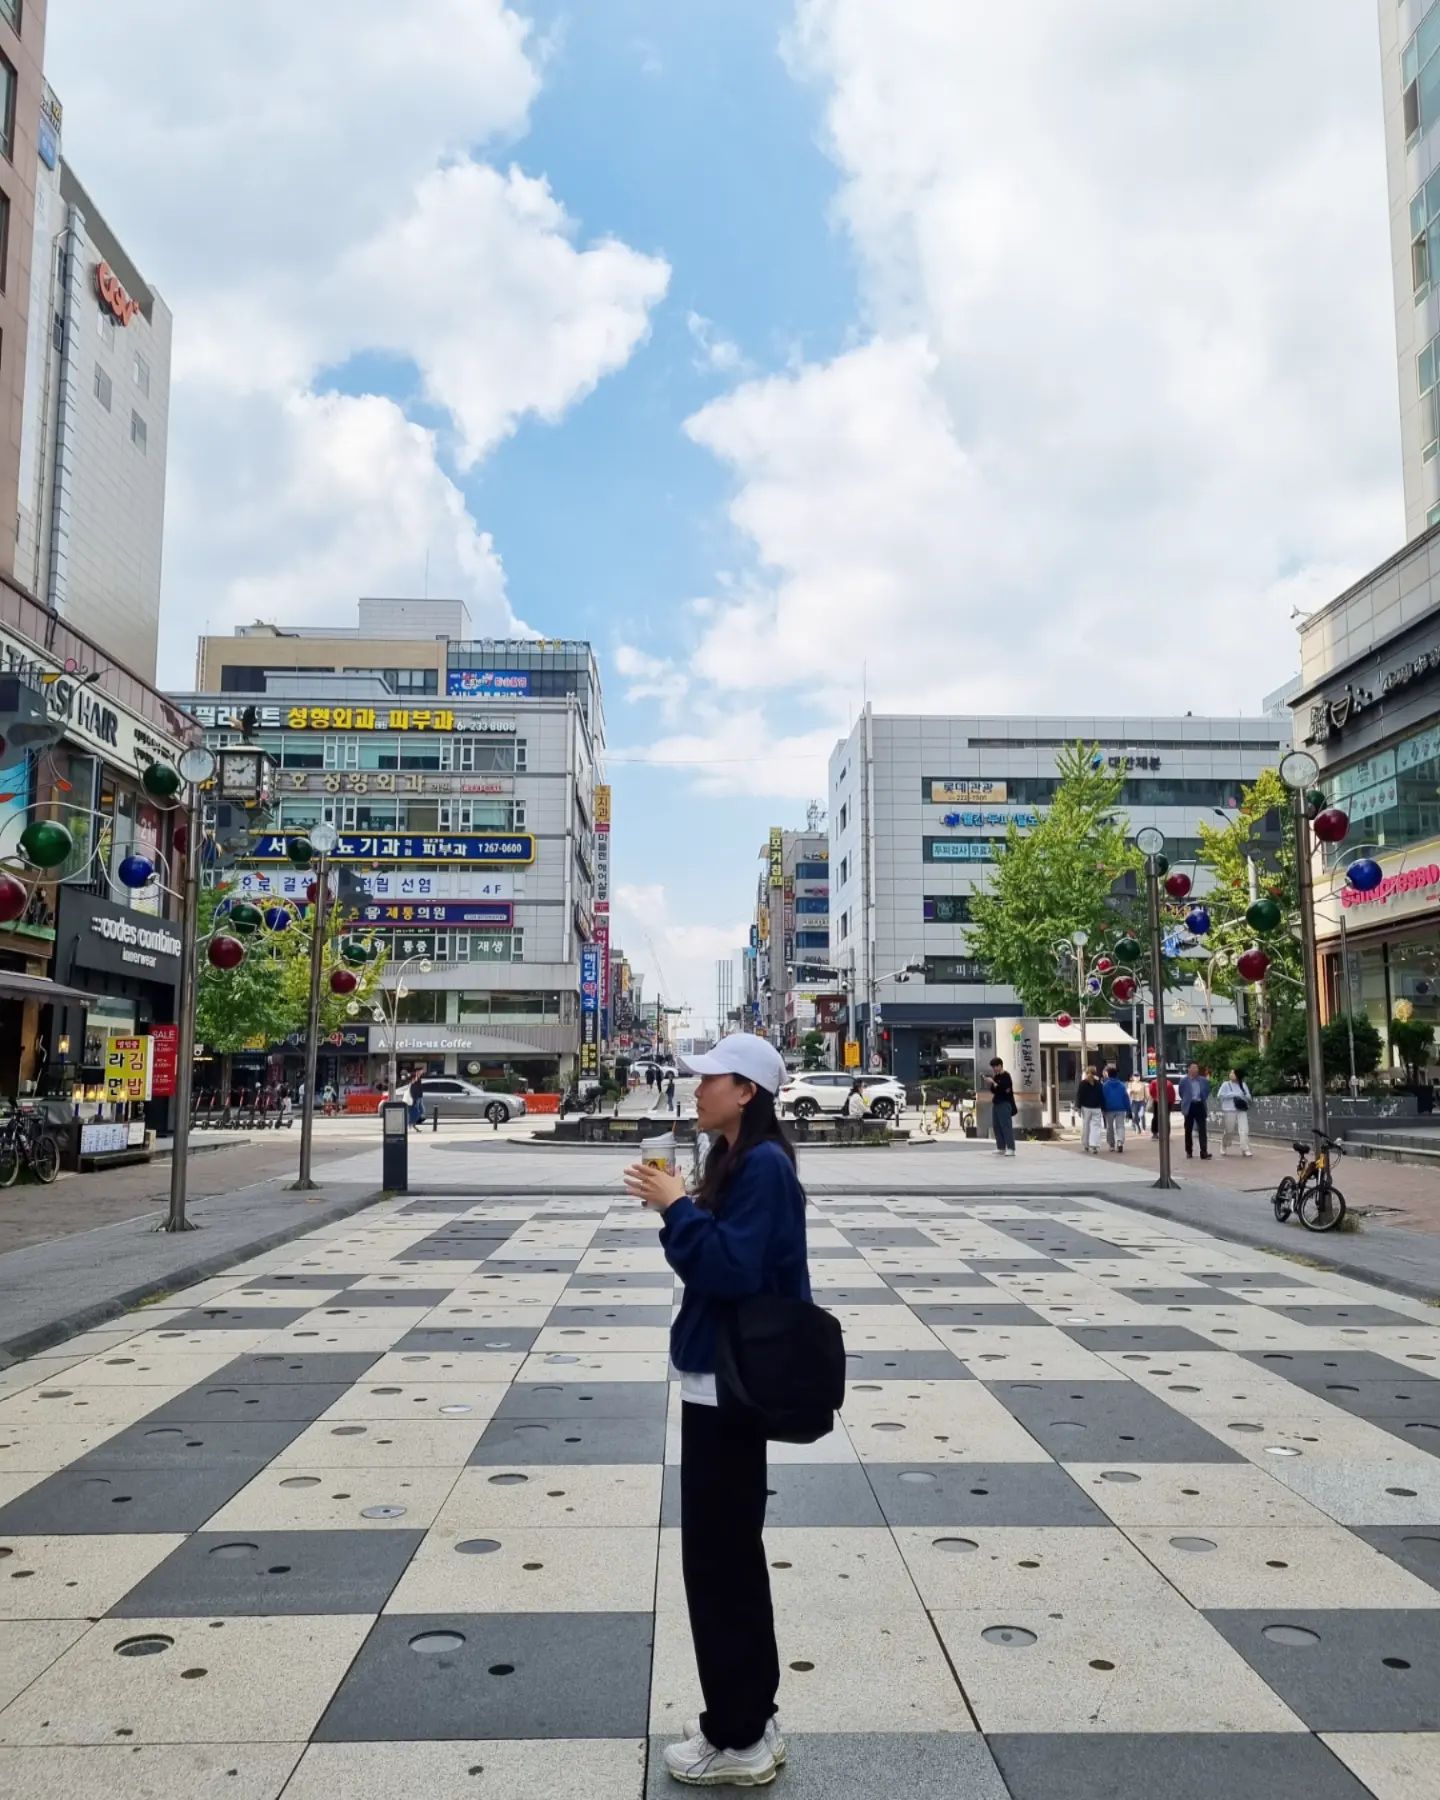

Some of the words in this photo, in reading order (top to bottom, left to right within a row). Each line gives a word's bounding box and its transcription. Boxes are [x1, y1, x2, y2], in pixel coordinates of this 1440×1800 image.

[79, 691, 117, 748] HAIR
[287, 707, 376, 731] 성형외과
[389, 709, 454, 731] 피부과
[423, 843, 468, 857] 피부과
[484, 842, 522, 854] 267-0600
[102, 917, 137, 945] codes
[137, 928, 181, 957] combine
[403, 940, 428, 953] 통증
[477, 941, 504, 953] 재생
[122, 947, 157, 968] innerwear
[152, 1029, 176, 1039] SALE
[378, 1038, 439, 1050] Agel-in-us
[440, 1038, 472, 1049] Coffee
[127, 1052, 144, 1096] 김밥
